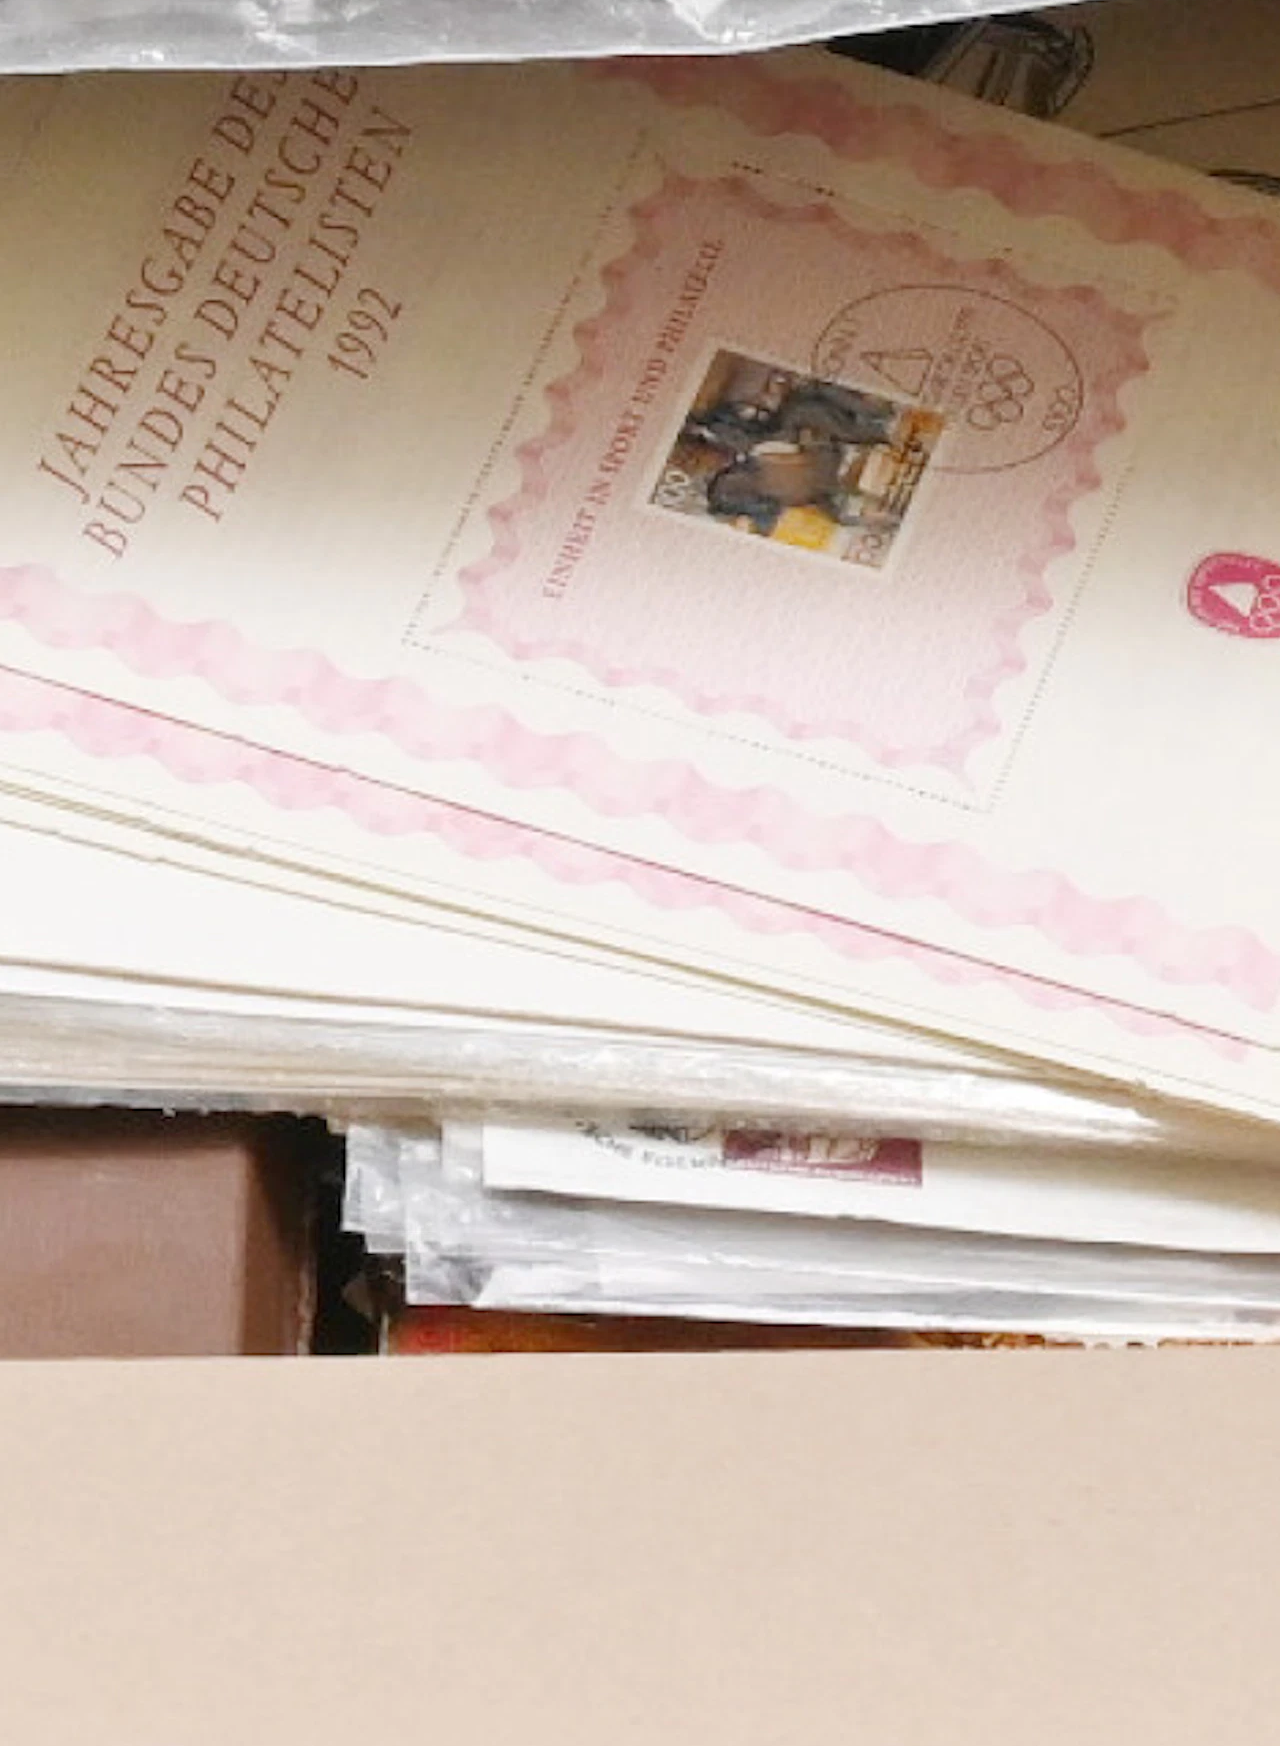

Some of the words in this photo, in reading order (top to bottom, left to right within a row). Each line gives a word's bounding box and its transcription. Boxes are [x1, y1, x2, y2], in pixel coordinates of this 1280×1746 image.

[37, 157, 235, 505] JAHRESGABE
[82, 341, 218, 560] BUNDES
[178, 105, 413, 523] PHILATELISTEN
[326, 285, 404, 381] 1992
